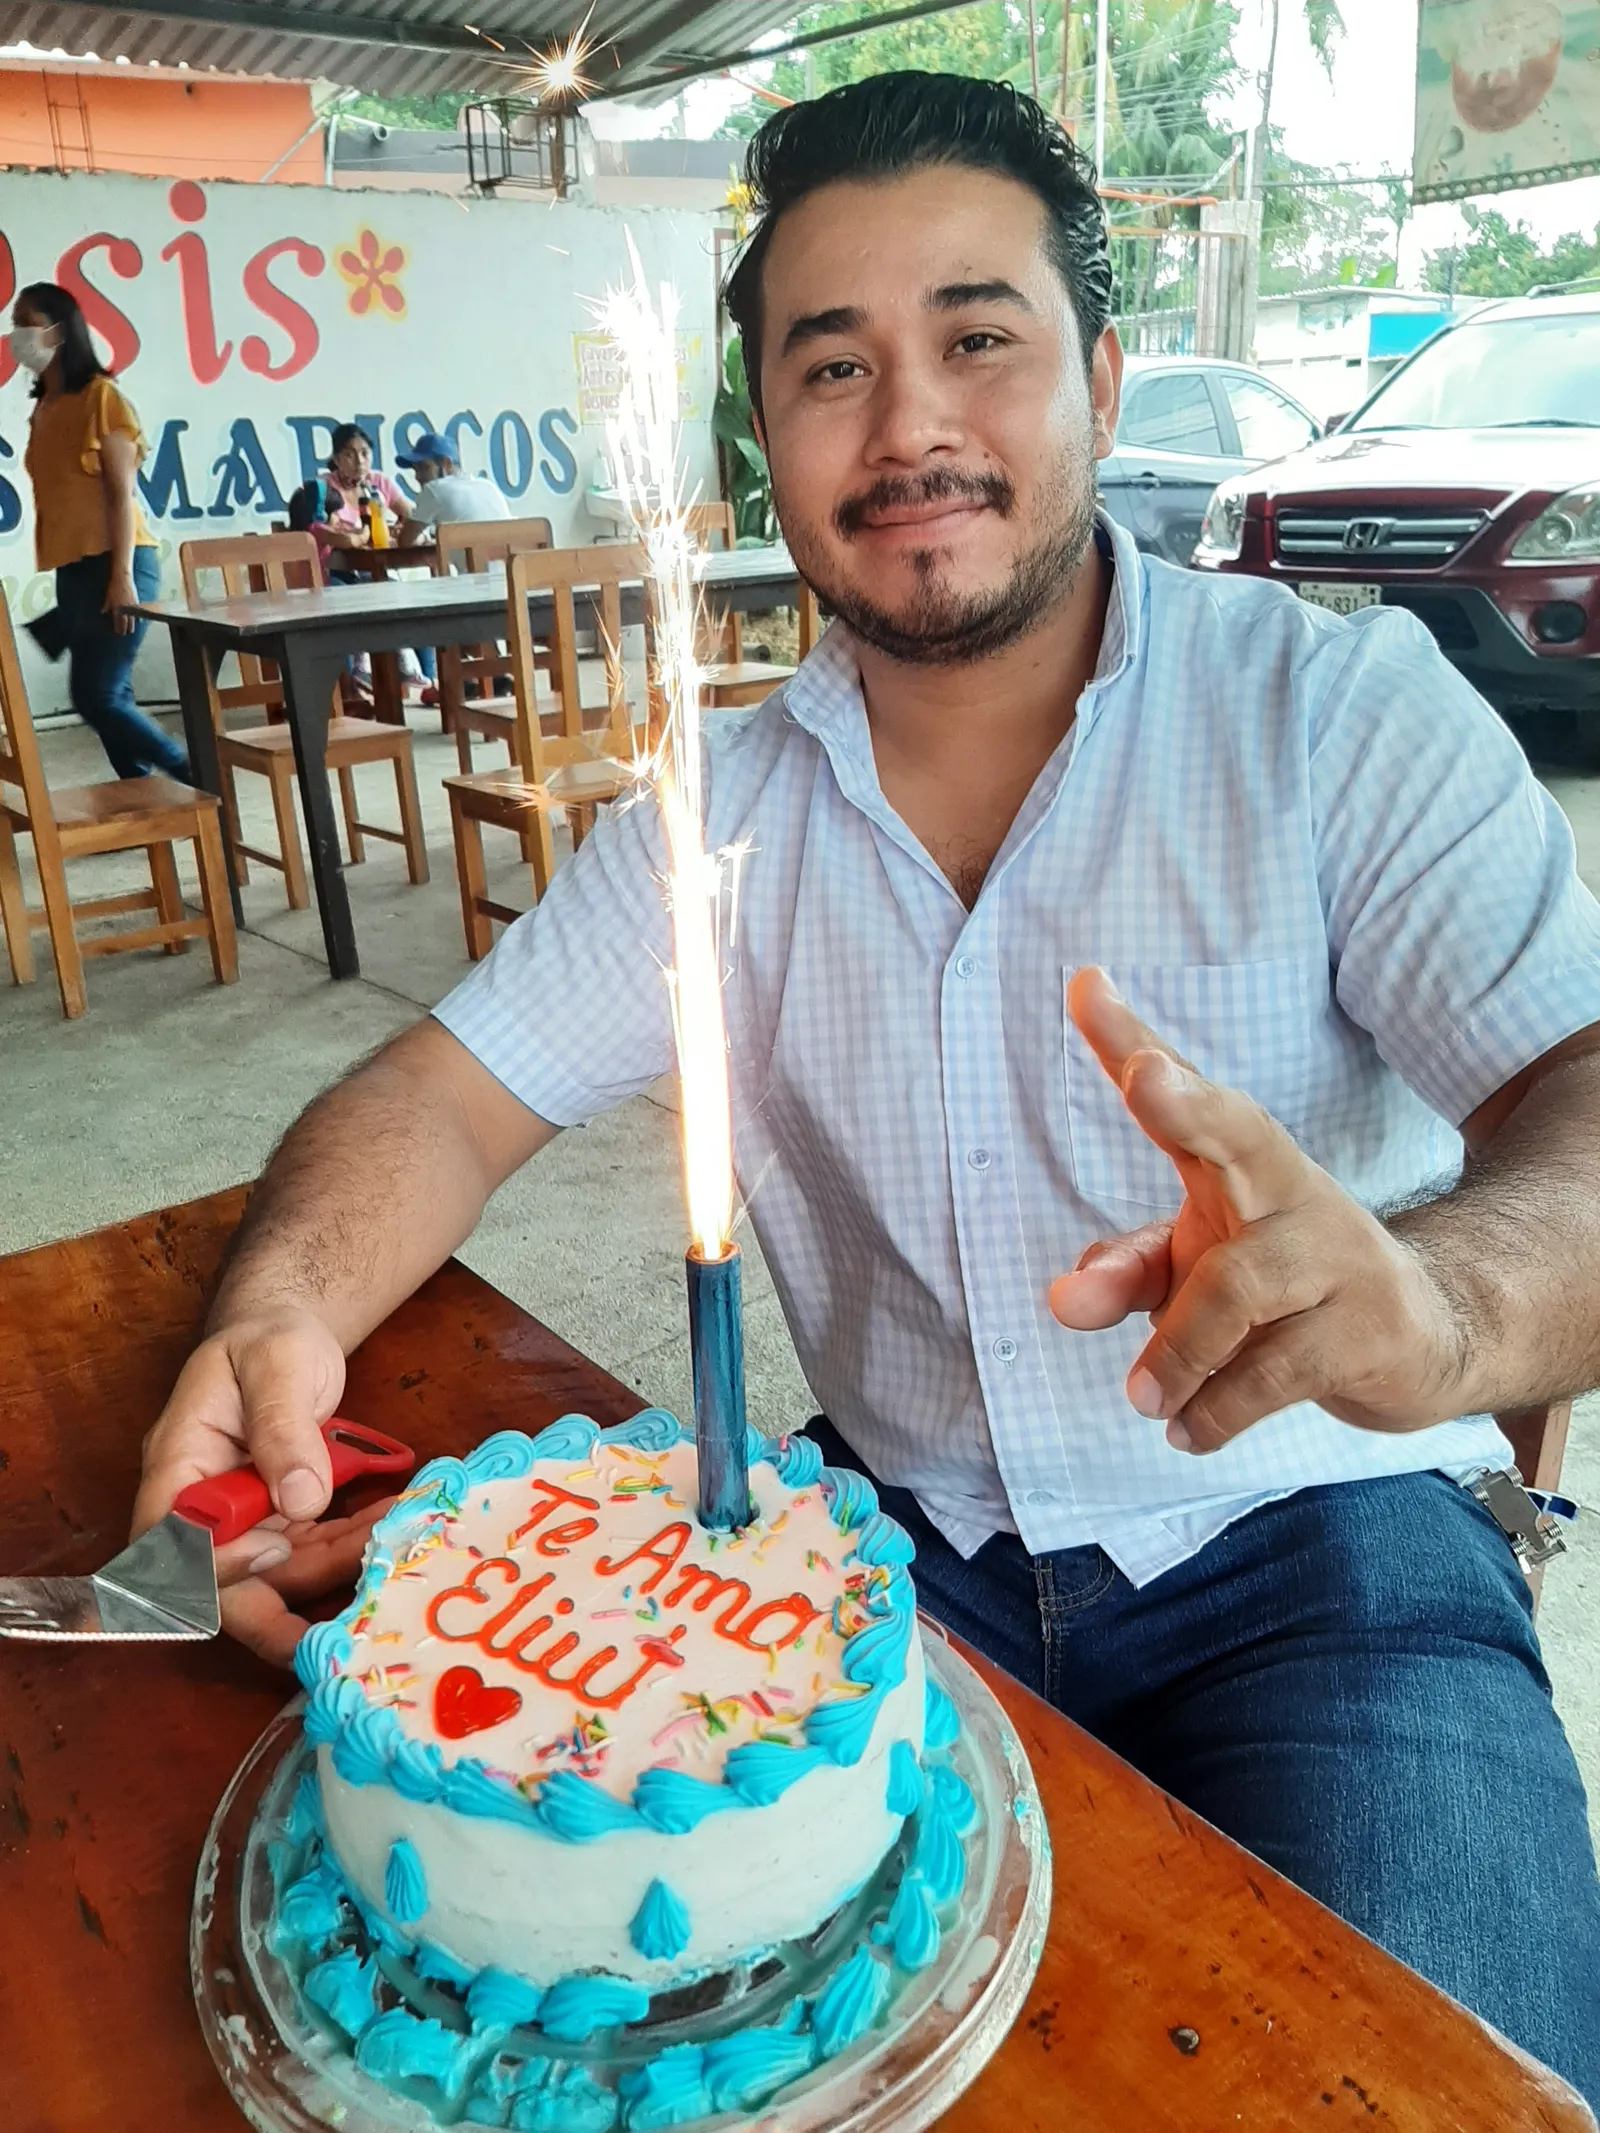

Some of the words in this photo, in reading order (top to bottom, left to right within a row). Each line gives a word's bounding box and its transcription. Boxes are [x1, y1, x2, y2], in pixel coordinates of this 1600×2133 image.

[0, 180, 325, 387] sis
[508, 1478, 601, 1558] Te
[593, 1521, 825, 1654] Amo
